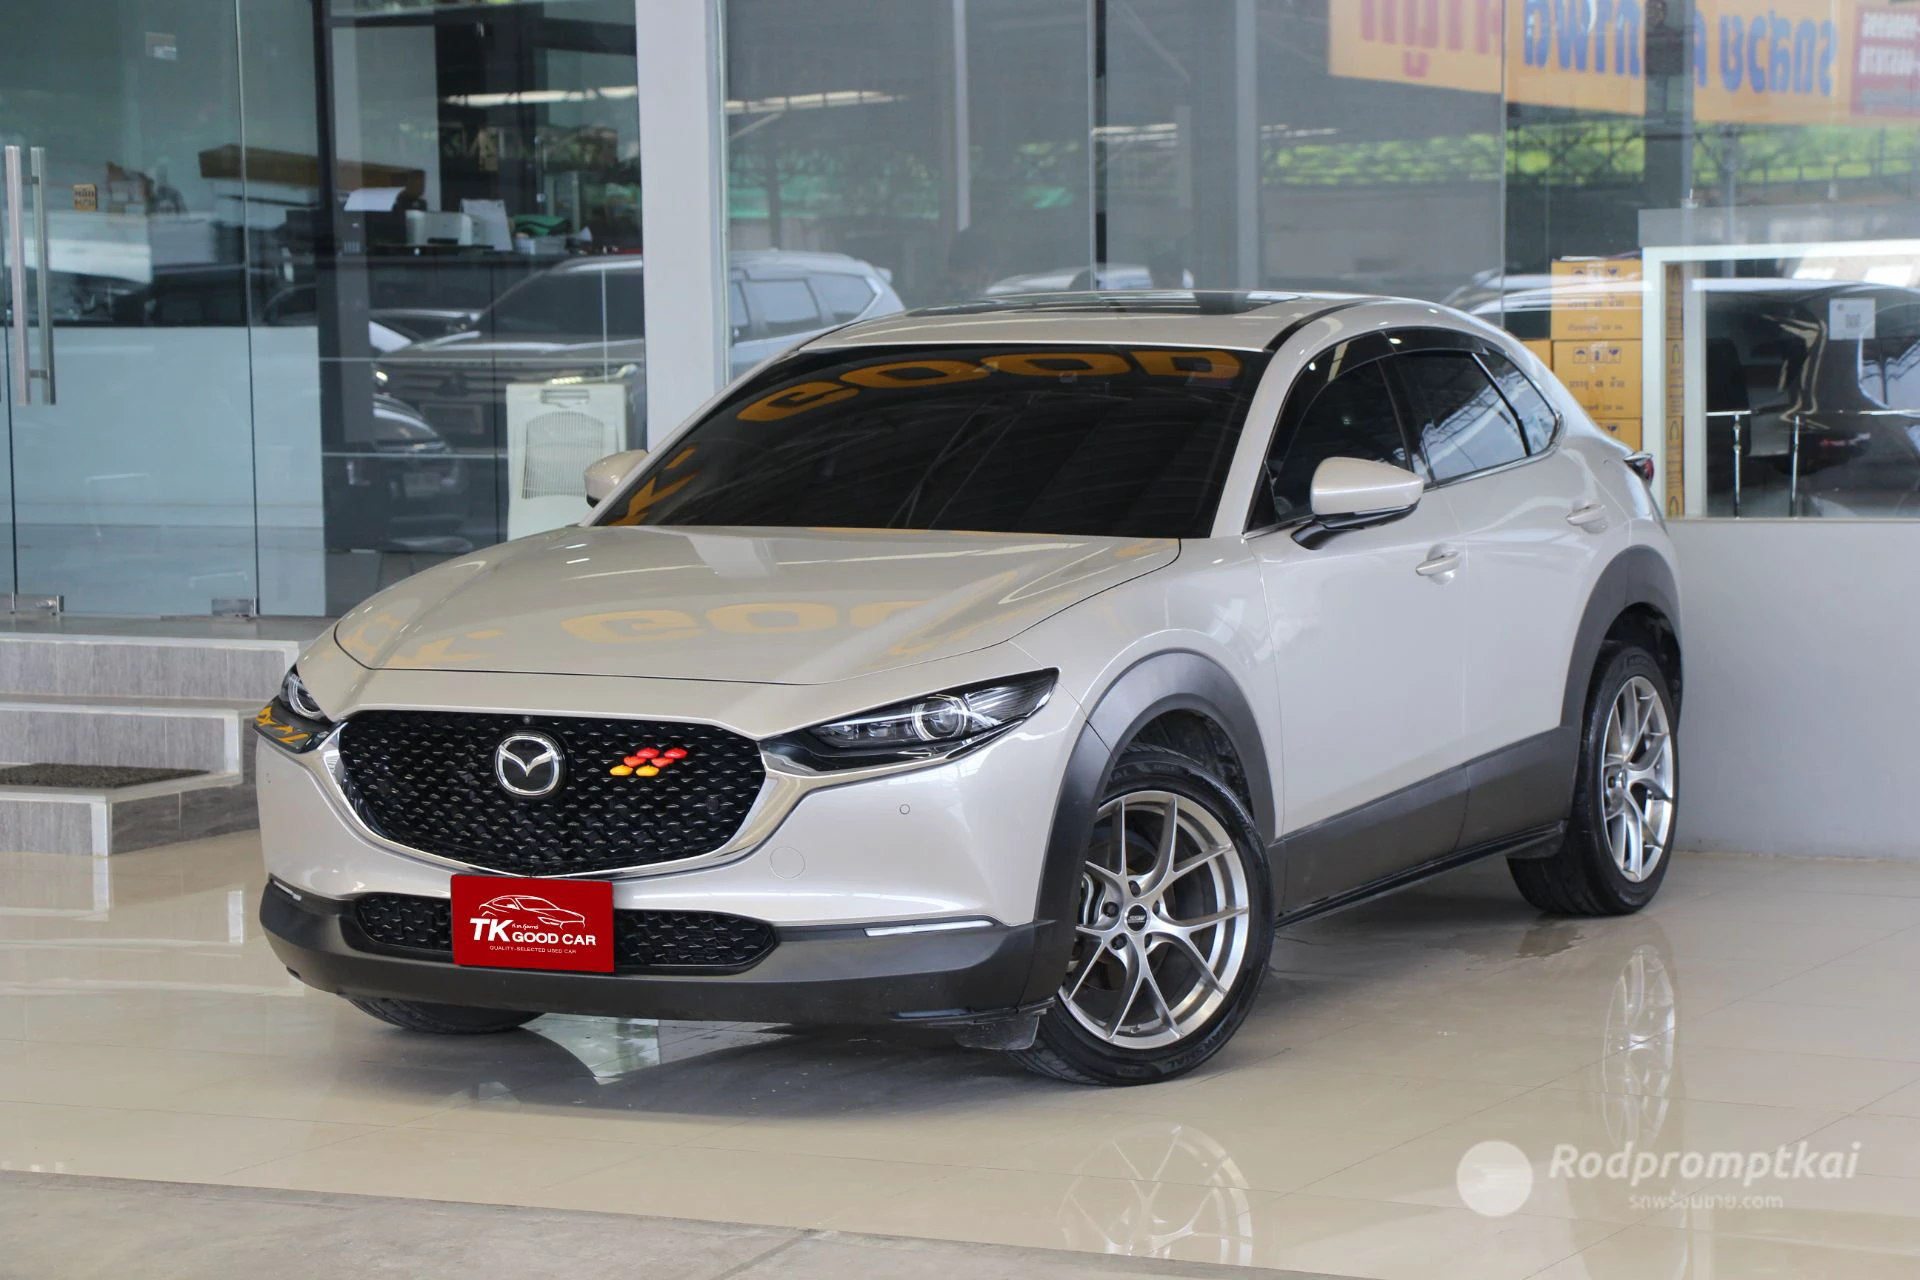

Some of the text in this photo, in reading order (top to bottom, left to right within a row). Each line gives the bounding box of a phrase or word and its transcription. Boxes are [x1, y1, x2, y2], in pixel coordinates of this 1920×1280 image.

[469, 917, 514, 942] TK
[512, 931, 596, 946] GOOD CAR
